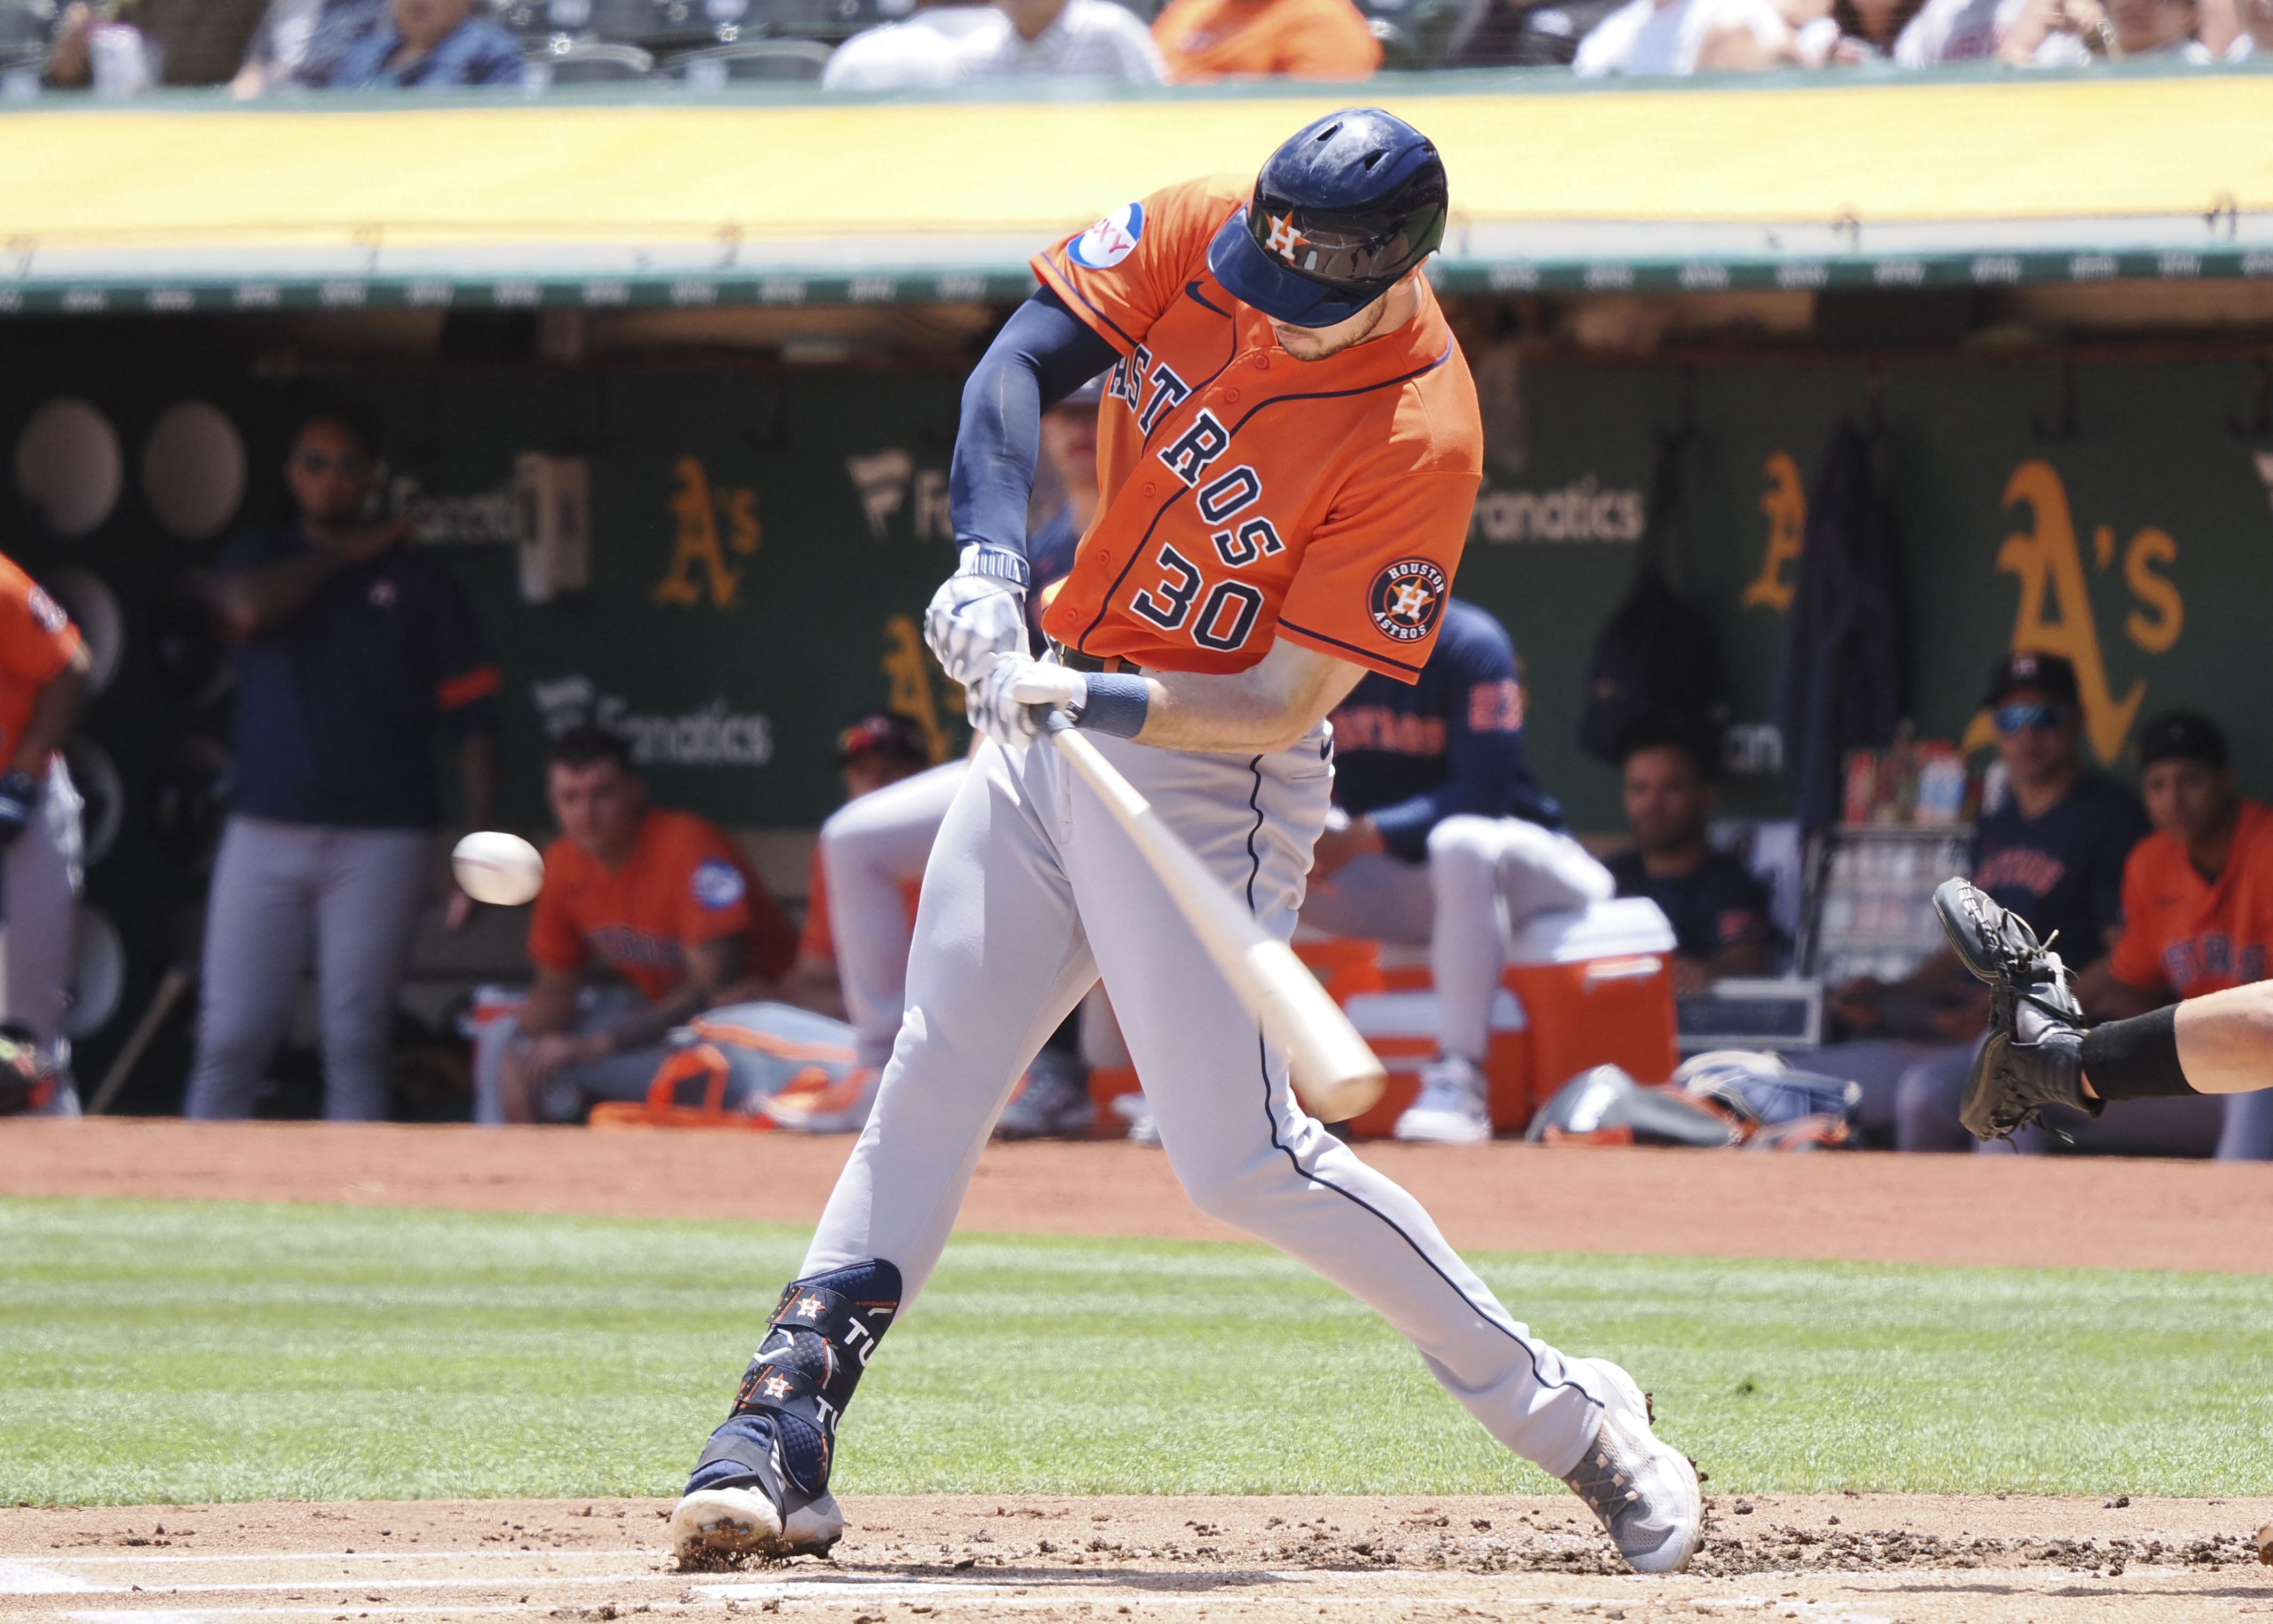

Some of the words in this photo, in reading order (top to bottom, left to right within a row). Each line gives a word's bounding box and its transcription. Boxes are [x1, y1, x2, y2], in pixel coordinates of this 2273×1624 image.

[1092, 219, 1130, 254] XY
[1265, 215, 1301, 260] H
[1107, 343, 1286, 569] ASTROS
[652, 457, 761, 607] A's
[1469, 475, 1645, 540] anatics
[1129, 542, 1265, 652] 30
[1388, 564, 1444, 593] HOUSTON
[1391, 584, 1429, 619] H
[1374, 612, 1427, 639] ASTROS
[1960, 460, 2184, 764] A's
